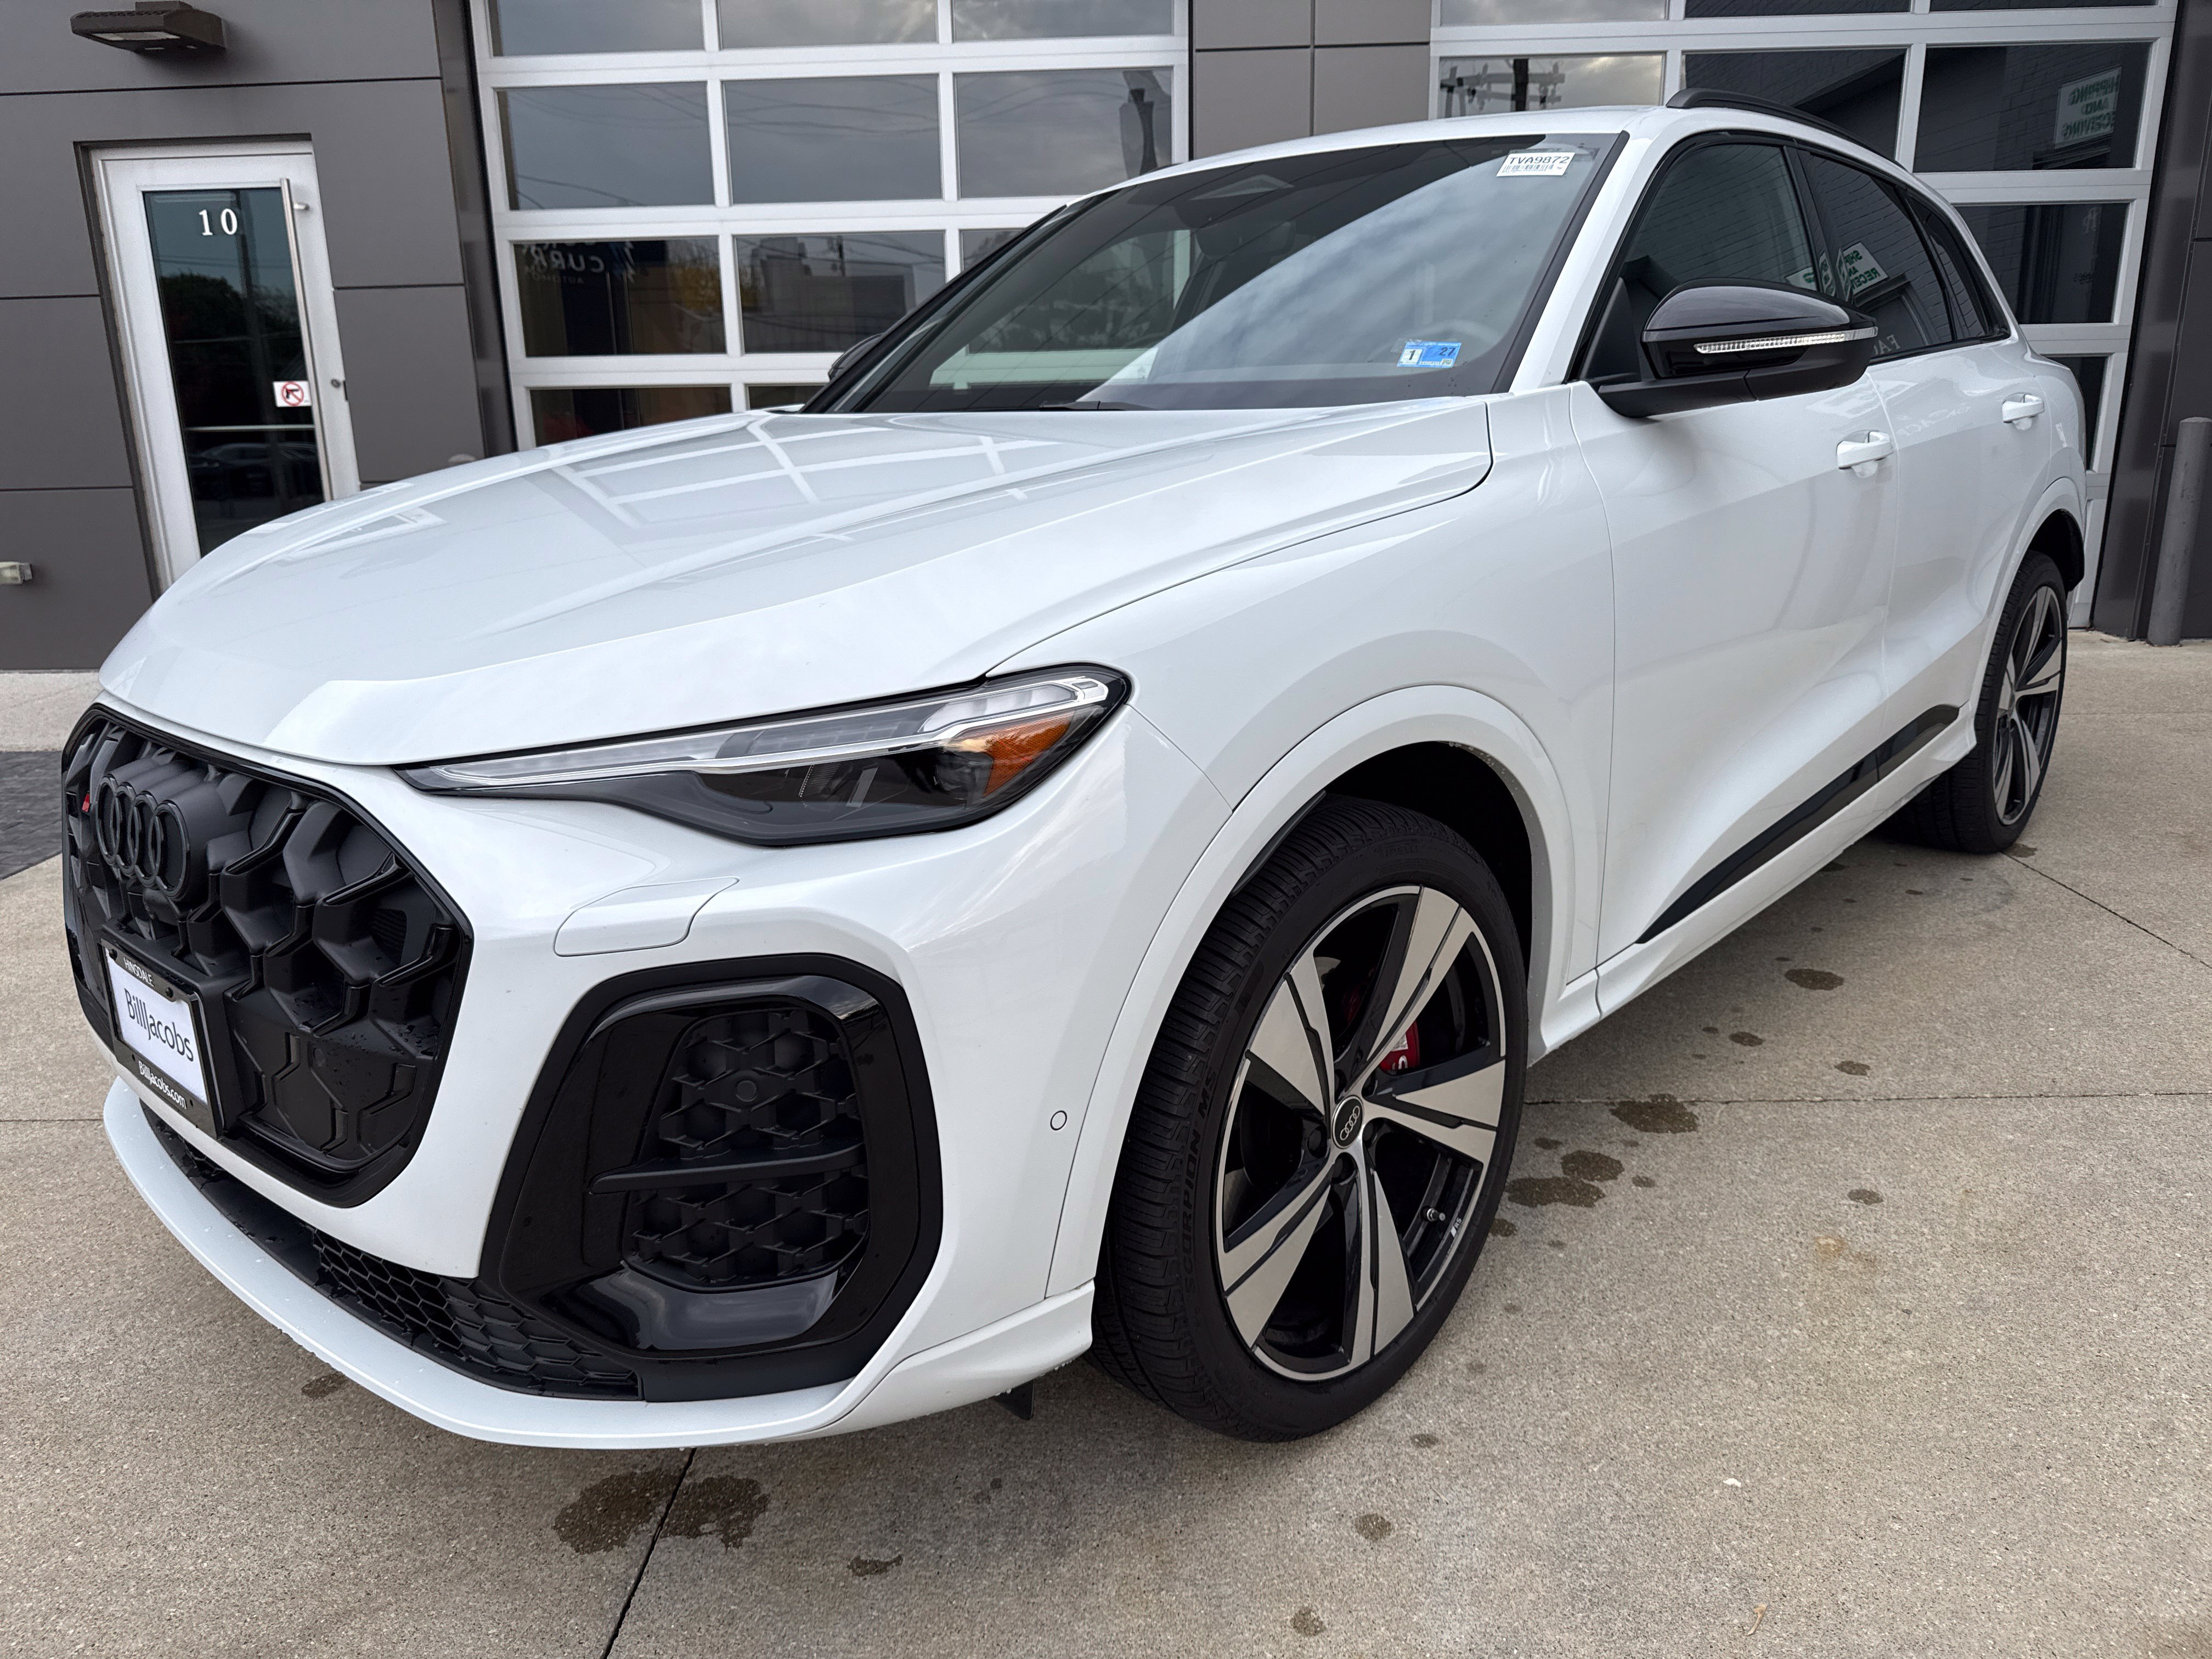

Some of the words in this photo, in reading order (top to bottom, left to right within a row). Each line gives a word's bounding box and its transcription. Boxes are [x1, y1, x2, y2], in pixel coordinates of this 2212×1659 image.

[1509, 156, 1570, 164] TVA9872
[198, 208, 238, 236] 10
[1408, 349, 1417, 360] 1
[1439, 347, 1456, 357] 27
[123, 957, 155, 988] HINSDALE
[124, 988, 194, 1062] BillJacobs
[138, 1060, 187, 1110] BillJacobs.com
[1182, 1128, 1202, 1295] SCORPION
